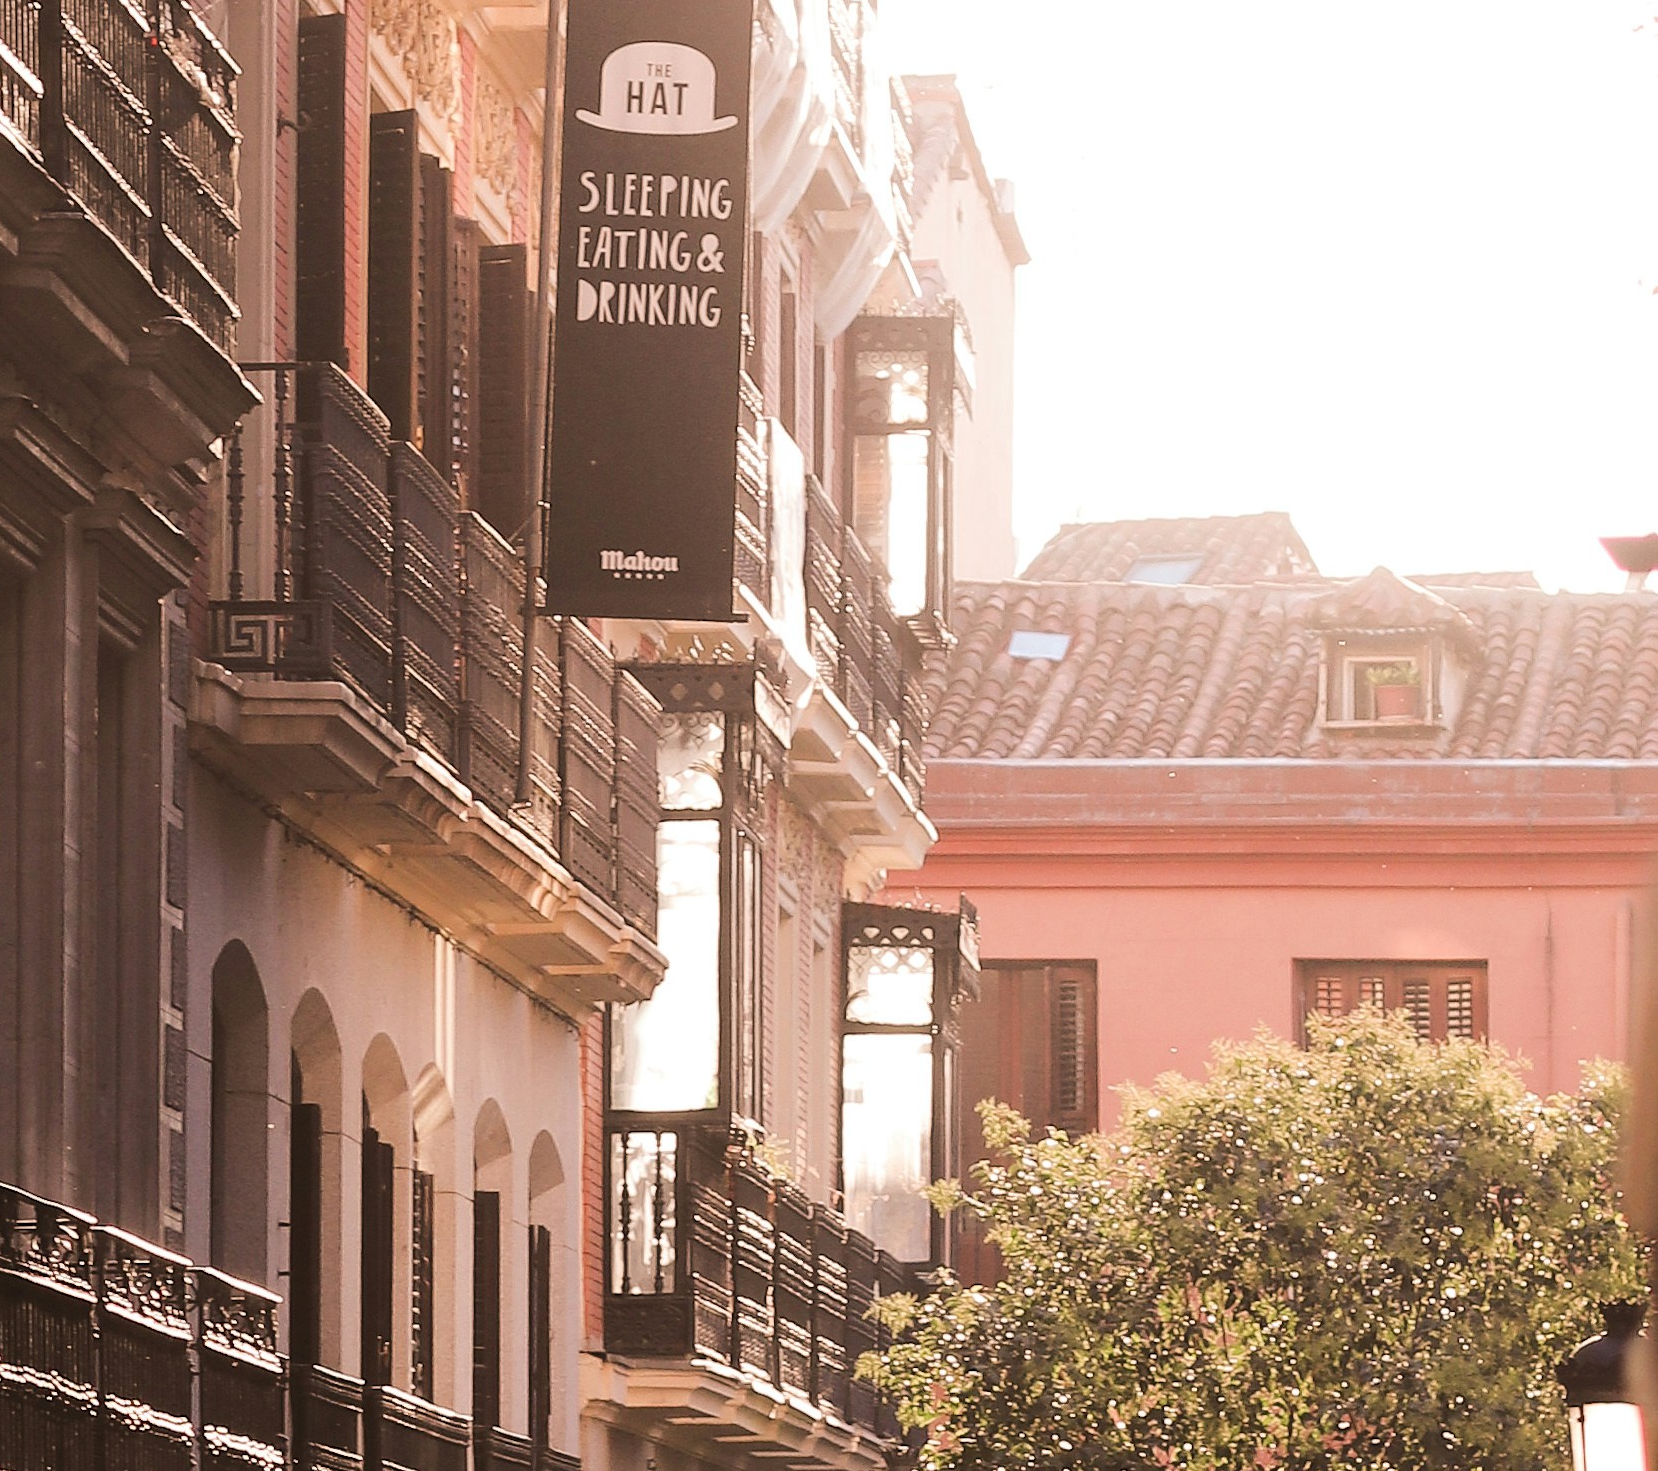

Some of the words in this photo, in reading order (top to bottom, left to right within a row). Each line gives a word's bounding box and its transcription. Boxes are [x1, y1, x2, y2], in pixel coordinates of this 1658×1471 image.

[646, 63, 673, 78] THE
[627, 81, 688, 116] HAT
[578, 170, 733, 220] SLEEPING
[576, 279, 722, 328] DRINKING
[600, 550, 679, 572] Mahou
